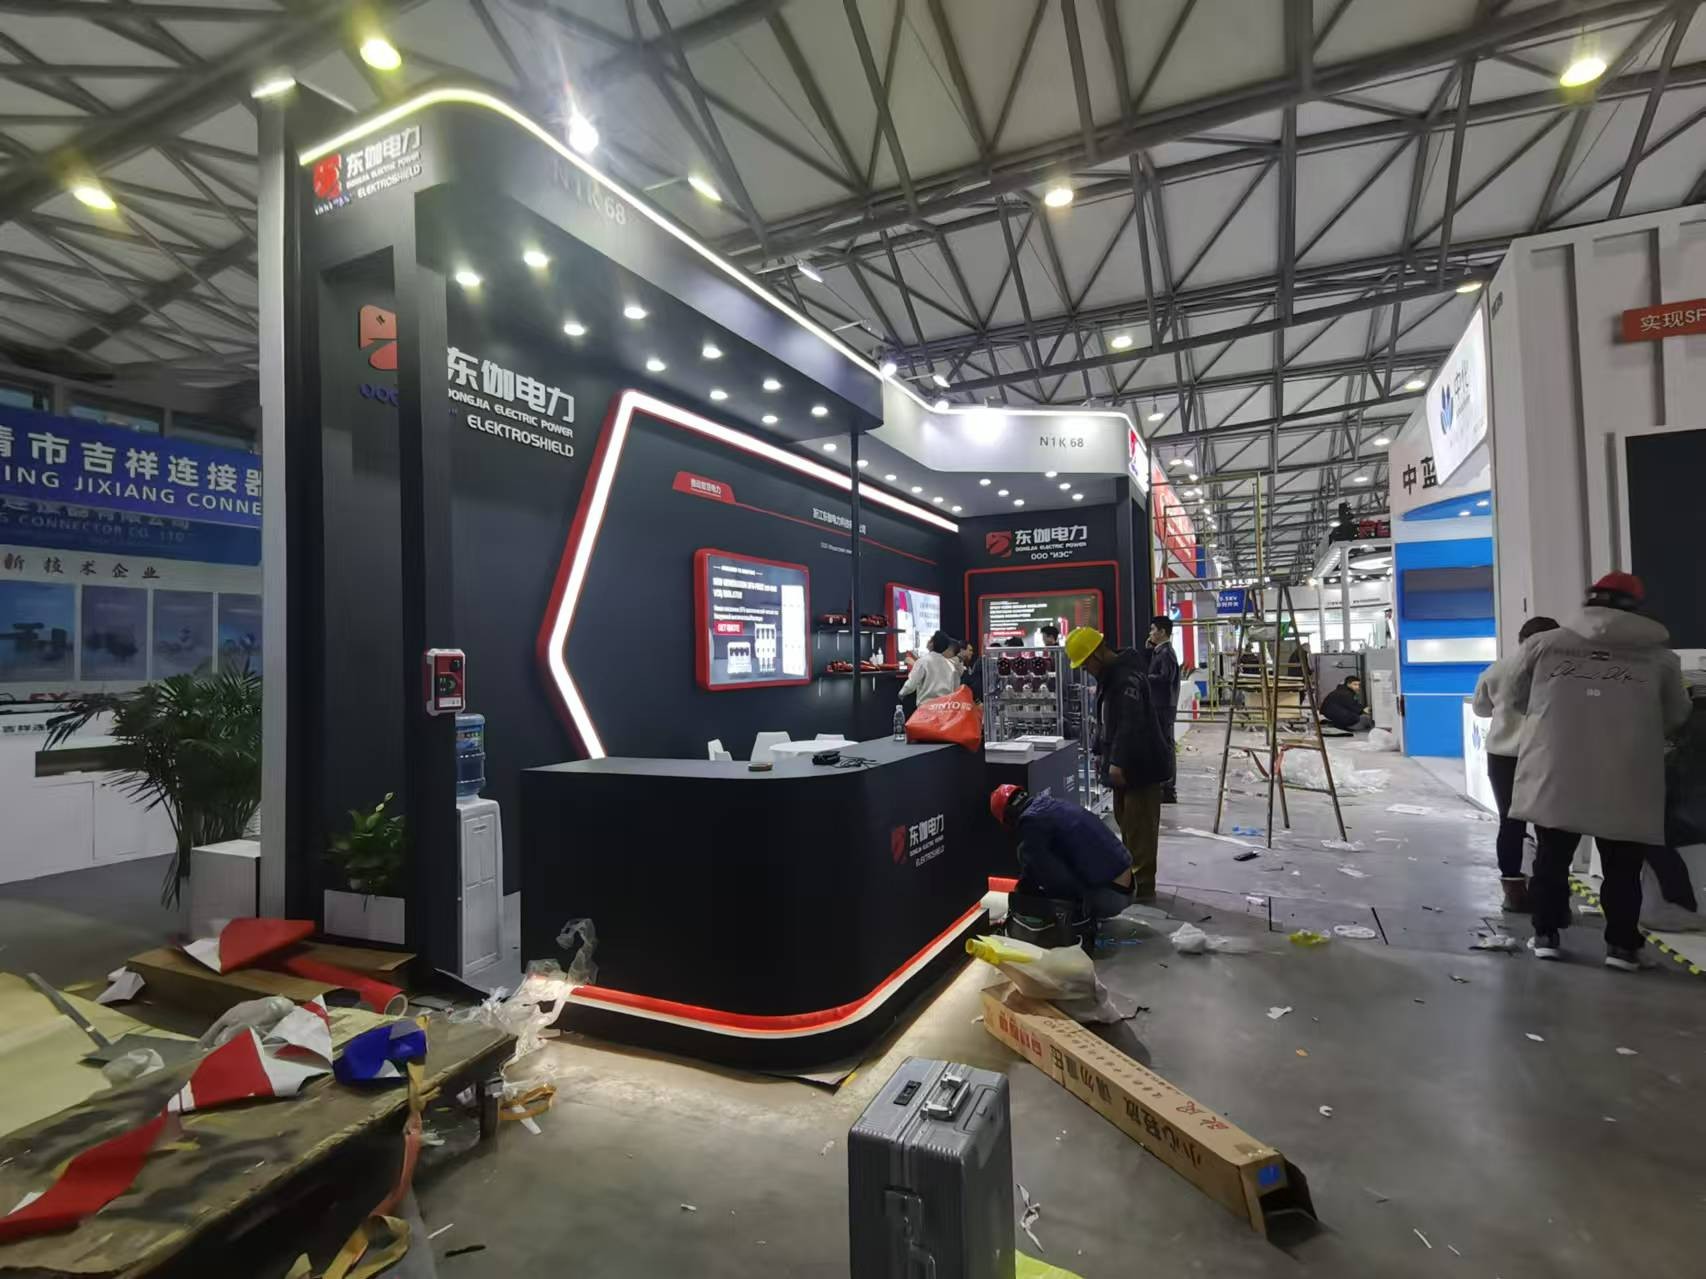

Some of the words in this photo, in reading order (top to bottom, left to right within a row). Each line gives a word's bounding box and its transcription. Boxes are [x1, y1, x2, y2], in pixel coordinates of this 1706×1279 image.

[346, 125, 420, 178] 东伽电力
[448, 346, 575, 422] 东伽电力
[467, 414, 574, 457] ELEKTROSHIELD
[494, 404, 538, 427] ELECTRIC
[541, 419, 574, 438] POWER
[74, 476, 175, 504] JIXIANG
[186, 492, 262, 515] CONNE
[1015, 525, 1088, 545] 东伽电力
[909, 814, 944, 848] 东伽电力
